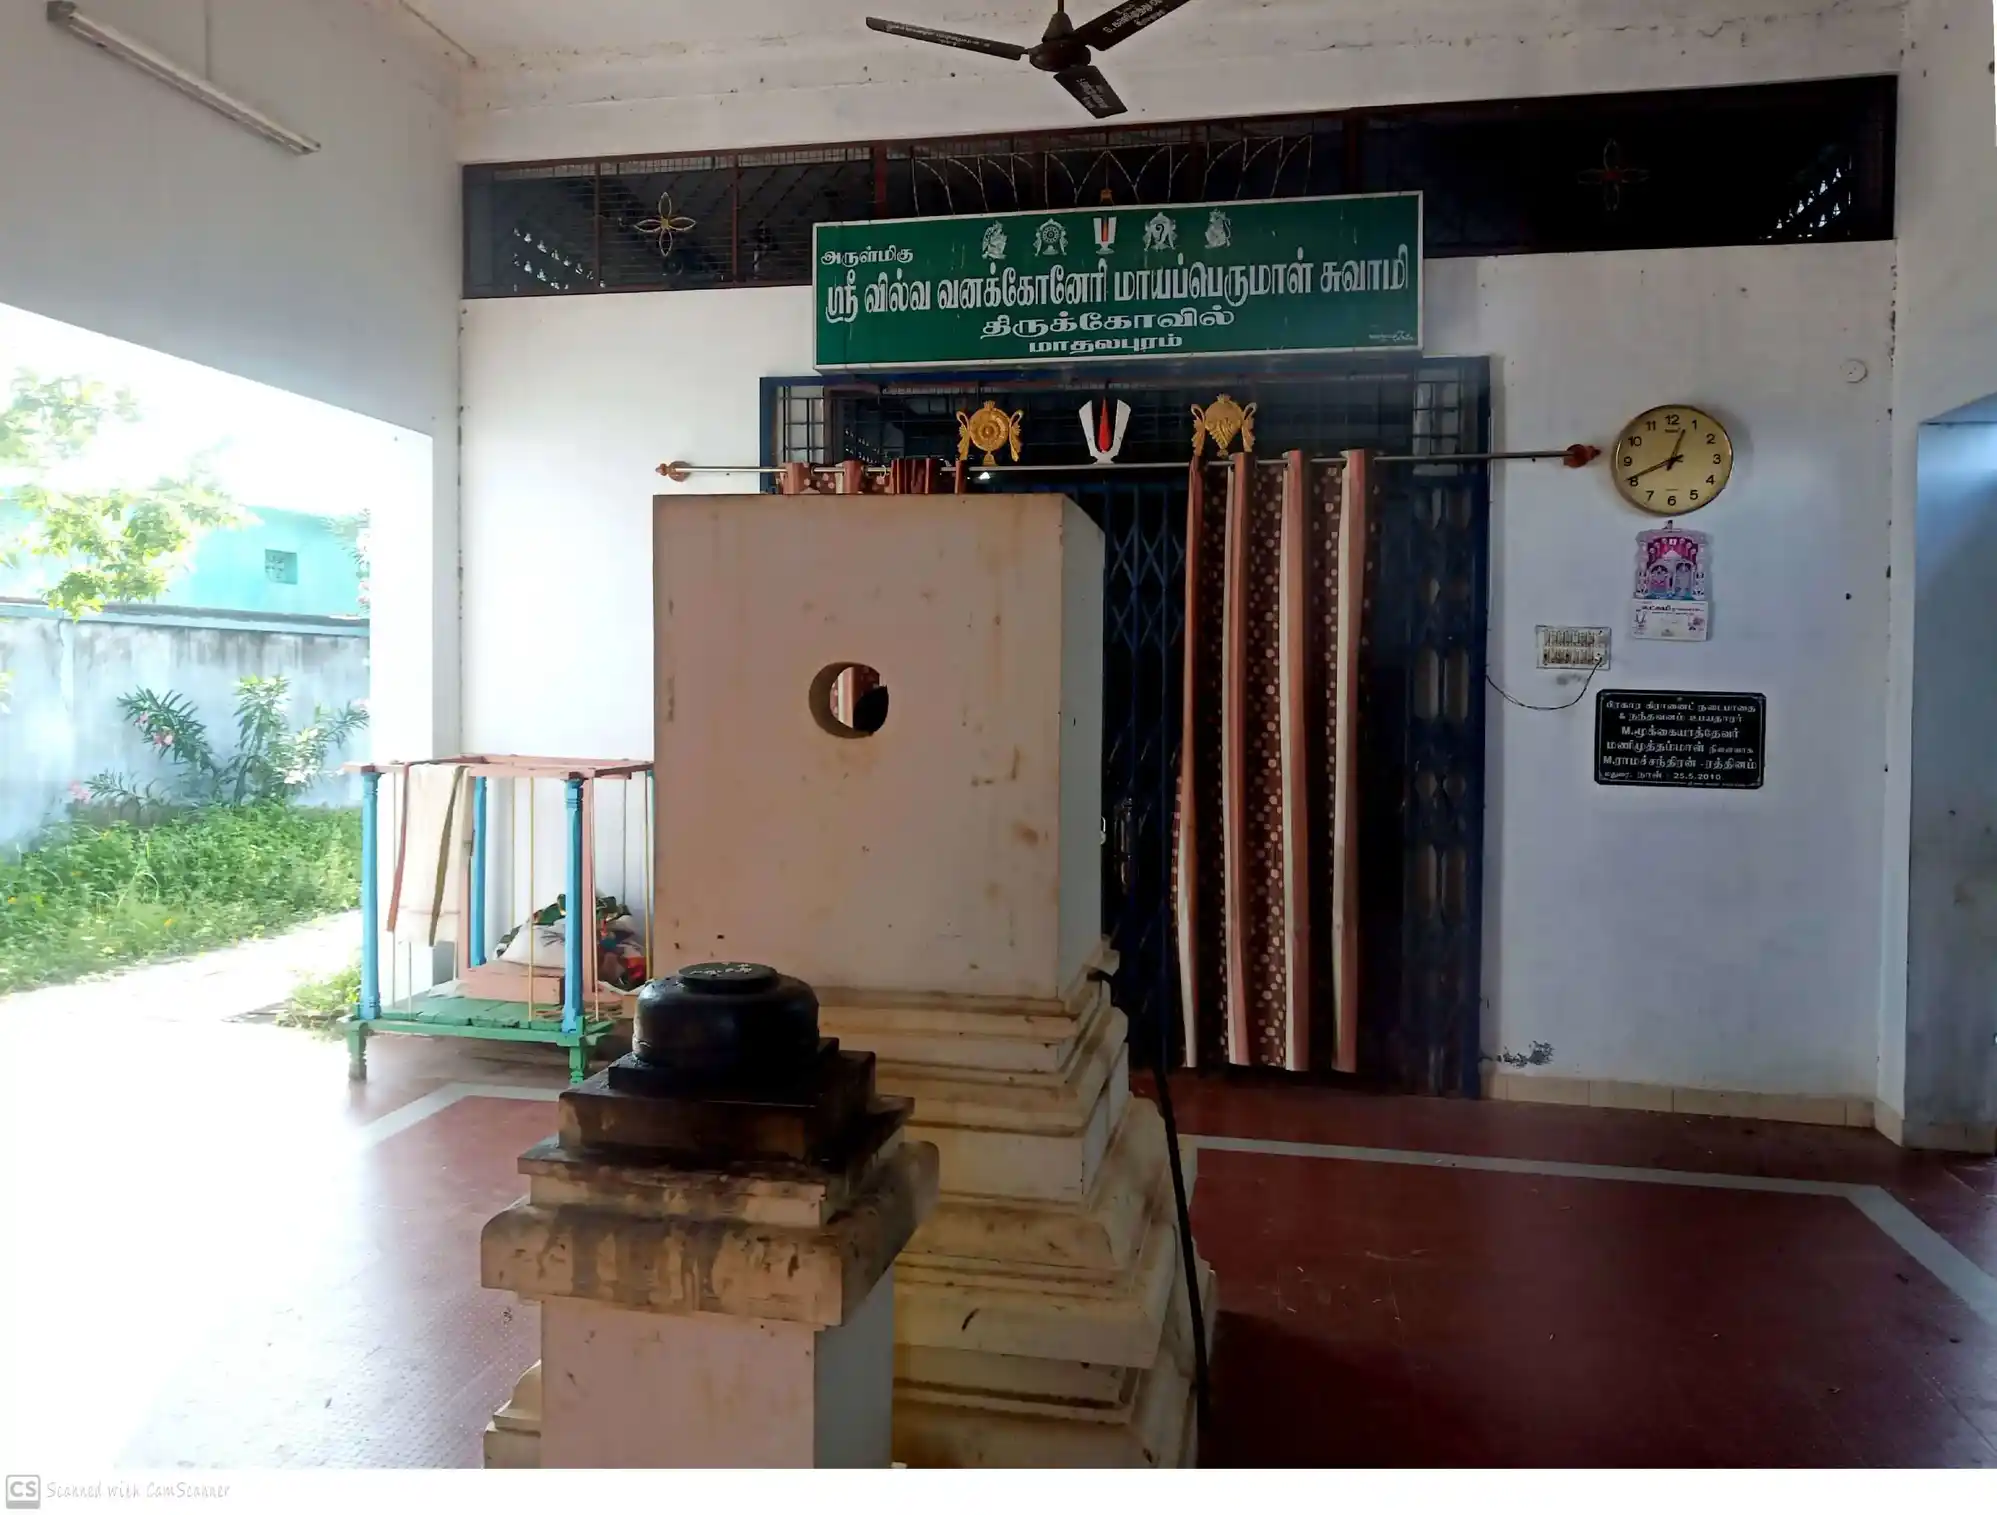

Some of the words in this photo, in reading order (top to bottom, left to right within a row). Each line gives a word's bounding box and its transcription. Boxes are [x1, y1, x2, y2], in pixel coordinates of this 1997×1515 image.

[821, 245, 914, 267] அருள்மிகு
[864, 268, 931, 313] வில்வ
[937, 258, 1108, 310] வனக்கோனேரி
[1114, 247, 1314, 307] மாயப்பெருமாள்
[1321, 244, 1408, 293] சுவாமி
[980, 305, 1235, 339] திருக்கோவில்
[1029, 333, 1182, 354] மாதலபுரம்
[1665, 414, 1680, 425] 12
[1692, 420, 1698, 430] 1
[1646, 421, 1656, 431] 11
[1628, 436, 1642, 447] 10
[1706, 433, 1716, 445] 2
[1623, 456, 1632, 467] 9
[1712, 454, 1721, 464] 3
[1629, 476, 1638, 487] 8
[1706, 475, 1715, 485] 4
[1646, 490, 1654, 501] 7
[1689, 490, 1699, 500] 5
[1667, 496, 1676, 506] 6
[1607, 739, 1705, 753] மணிமுத்தம்மாள்
